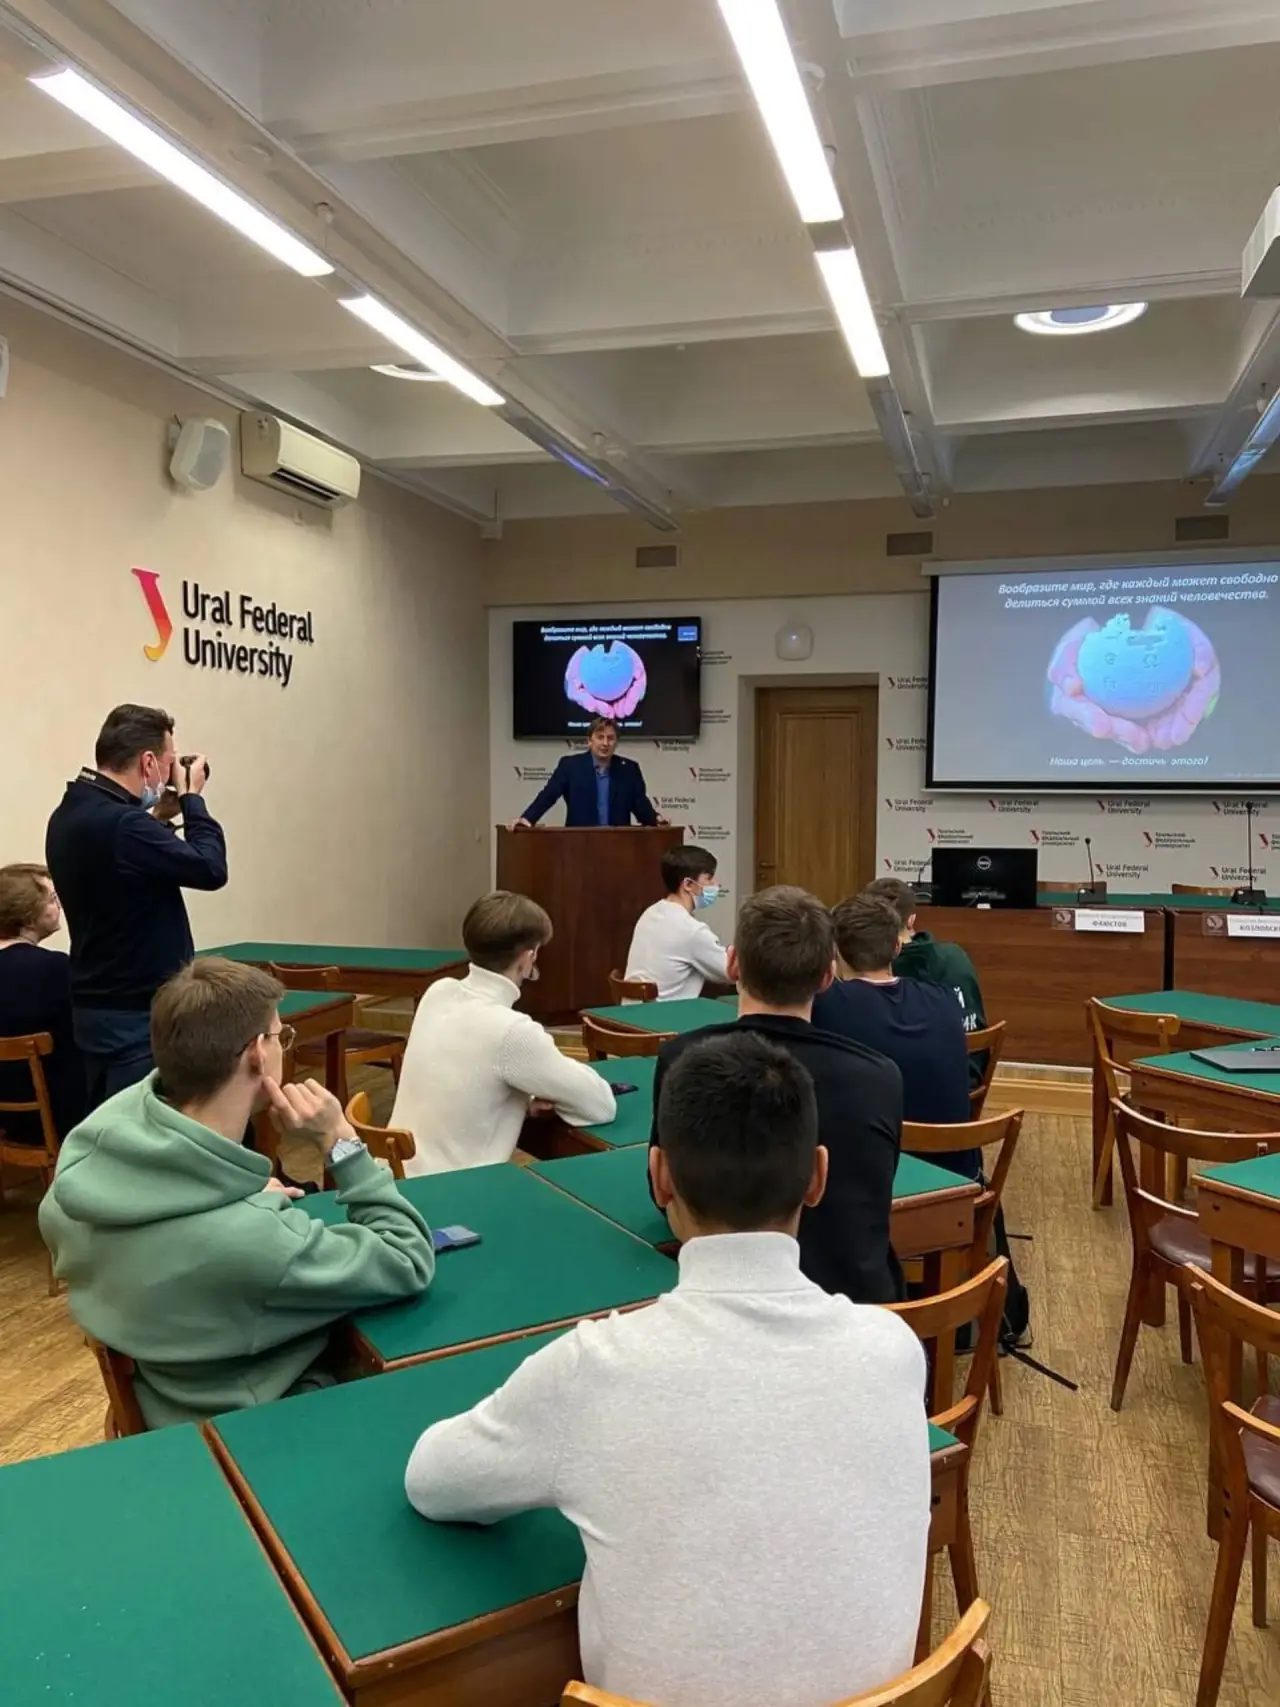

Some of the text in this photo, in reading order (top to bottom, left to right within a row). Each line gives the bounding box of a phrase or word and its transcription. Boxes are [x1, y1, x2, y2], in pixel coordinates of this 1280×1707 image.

[998, 573, 1279, 596] Вообразите мир, где каждый может свободно
[1005, 596, 1060, 609] делиться
[1061, 594, 1105, 608] суммой
[1107, 593, 1134, 605] всех
[1135, 591, 1177, 604] знаний
[182, 580, 314, 644] Ural Federal
[183, 627, 294, 688] University
[1106, 871, 1141, 880] University
[1123, 864, 1149, 872] Federal
